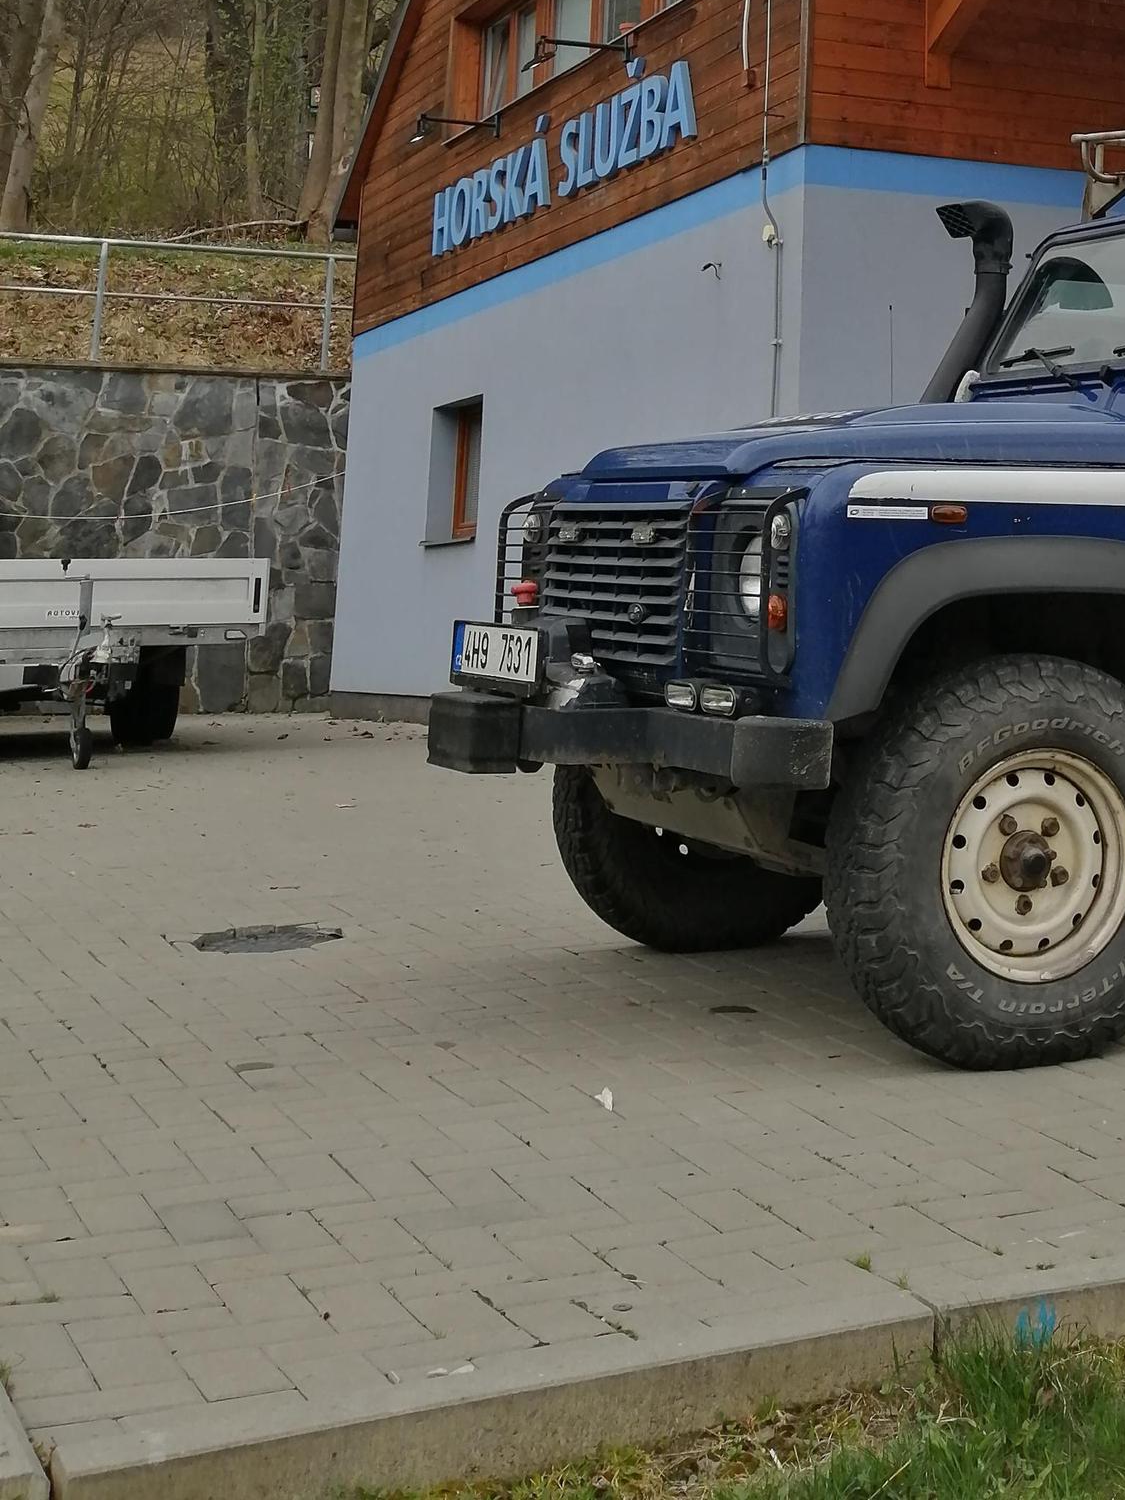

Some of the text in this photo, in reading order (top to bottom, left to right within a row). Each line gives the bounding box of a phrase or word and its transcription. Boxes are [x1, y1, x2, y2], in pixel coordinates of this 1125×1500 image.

[432, 57, 697, 257] HORSKÁ SLUŽBA
[464, 631, 533, 676] 4H9 7531
[946, 962, 985, 1004] T/A
